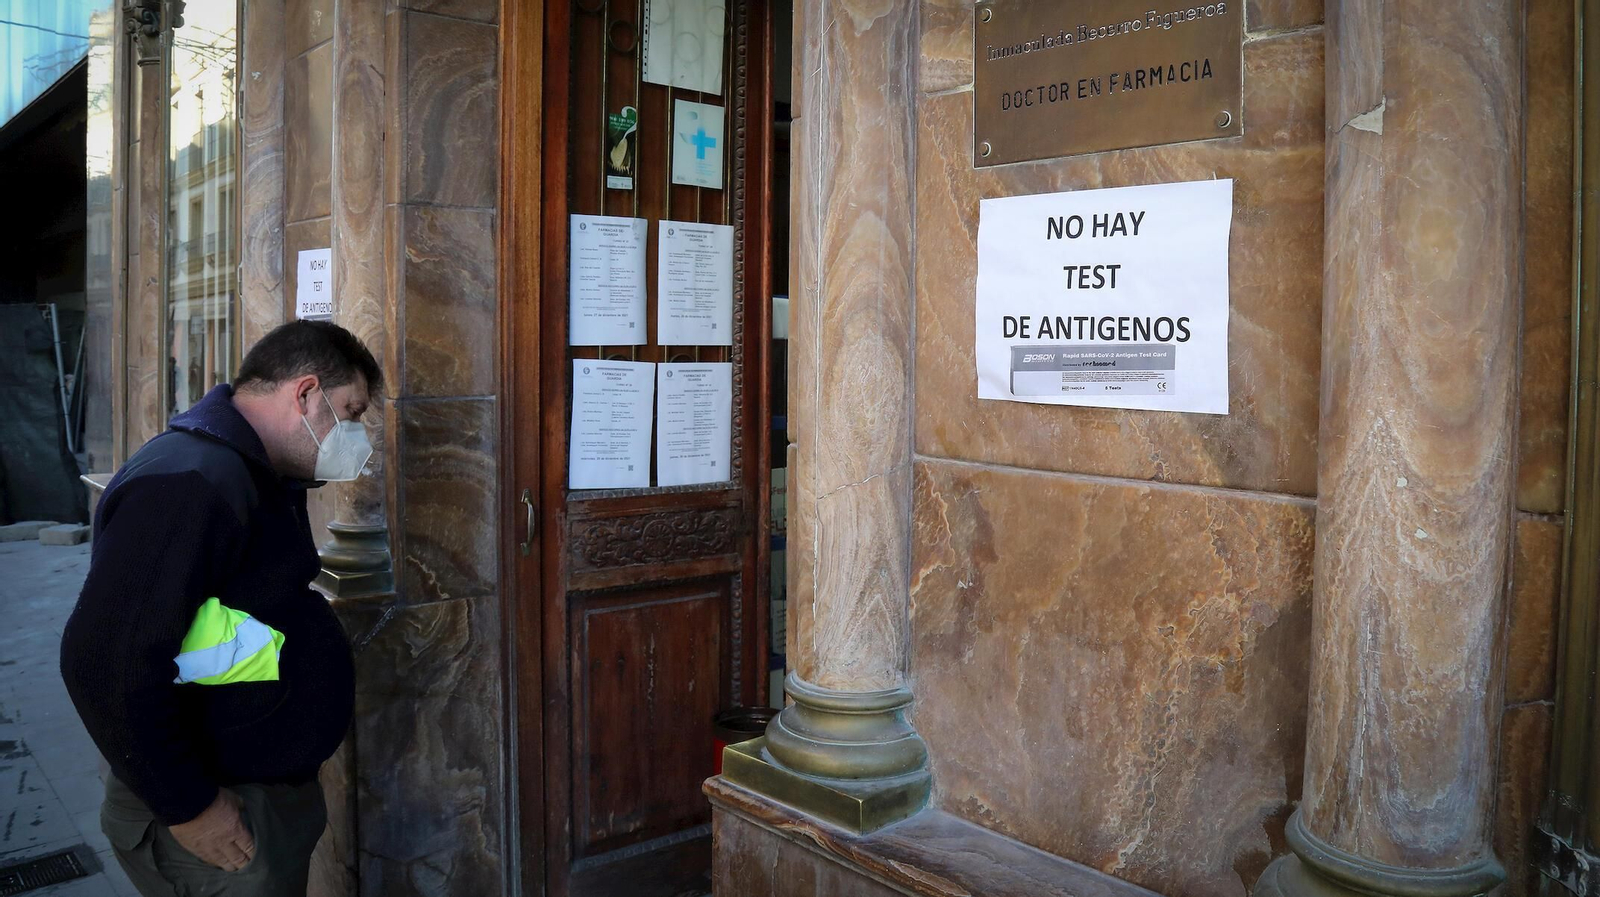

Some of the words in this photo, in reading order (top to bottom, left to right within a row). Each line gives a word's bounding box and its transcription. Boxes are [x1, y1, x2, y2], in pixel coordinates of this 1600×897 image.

[986, 30, 1073, 61] Inmaculada
[1077, 20, 1142, 43] Becerro
[1145, 2, 1227, 30] Figueroa
[1001, 82, 1070, 111] DOCTOR
[1077, 76, 1102, 99] EN
[1109, 58, 1213, 95] FARMACIA
[1046, 214, 1084, 240] NO
[1092, 211, 1146, 238] HAY
[310, 260, 317, 270] NO
[318, 259, 328, 270] HAY
[1063, 264, 1121, 290] TEST
[314, 281, 322, 292] TEST
[302, 302, 308, 312] DE
[1003, 315, 1031, 339] DE
[1037, 316, 1191, 343] ANTIGENOS
